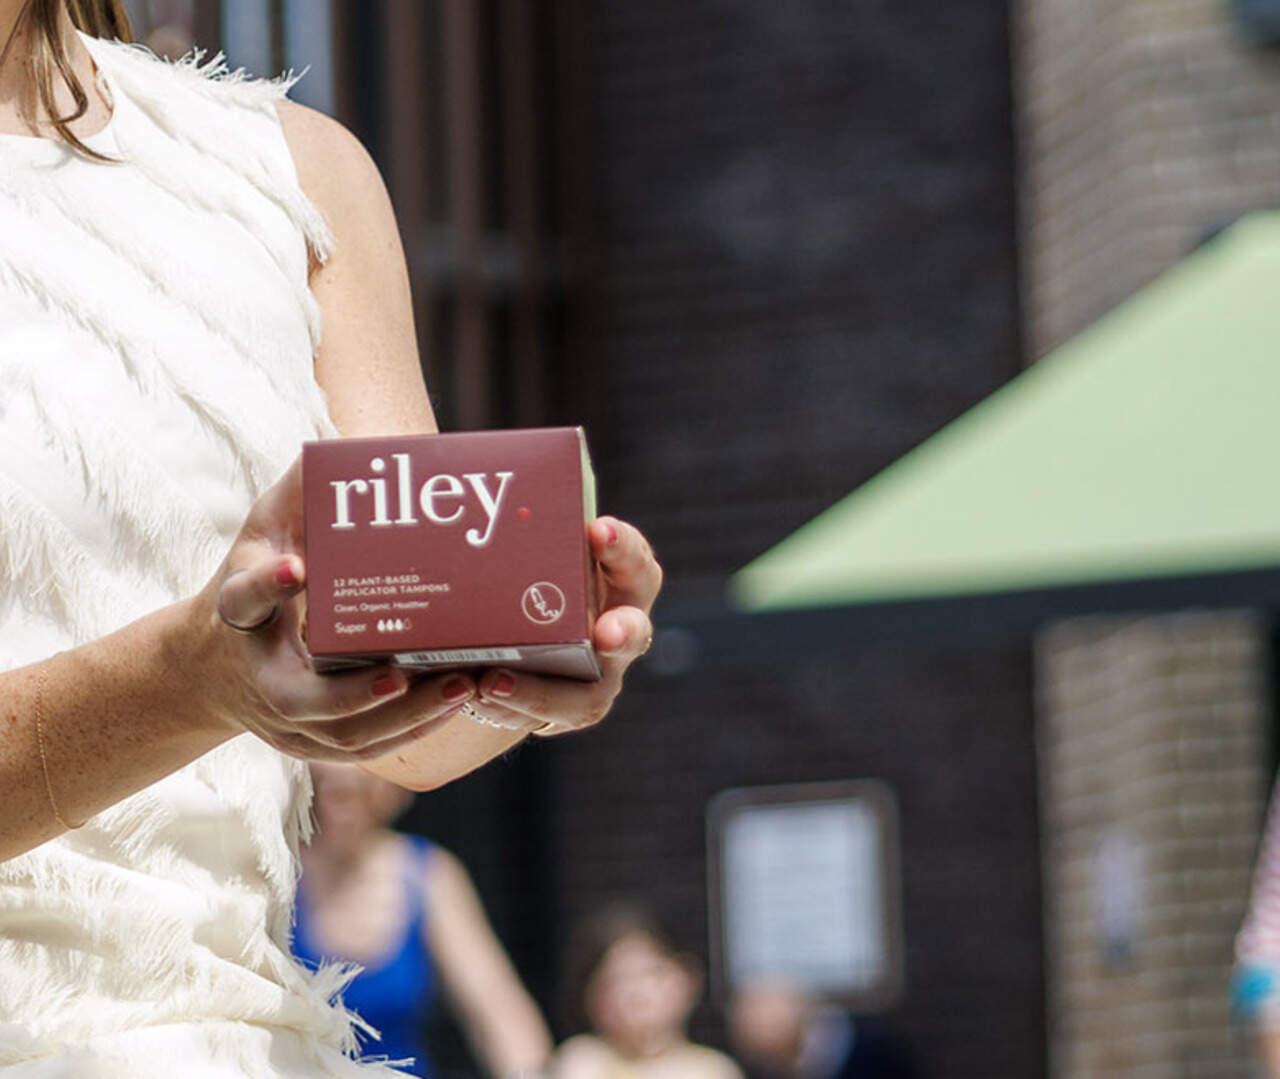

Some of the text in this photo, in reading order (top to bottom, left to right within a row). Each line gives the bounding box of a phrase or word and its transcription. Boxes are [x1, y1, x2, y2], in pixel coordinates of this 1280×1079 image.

[333, 574, 420, 588] 12 PLANT-BASED
[333, 583, 451, 597] APPLICATOR TAMPONS
[334, 622, 367, 634] Super
